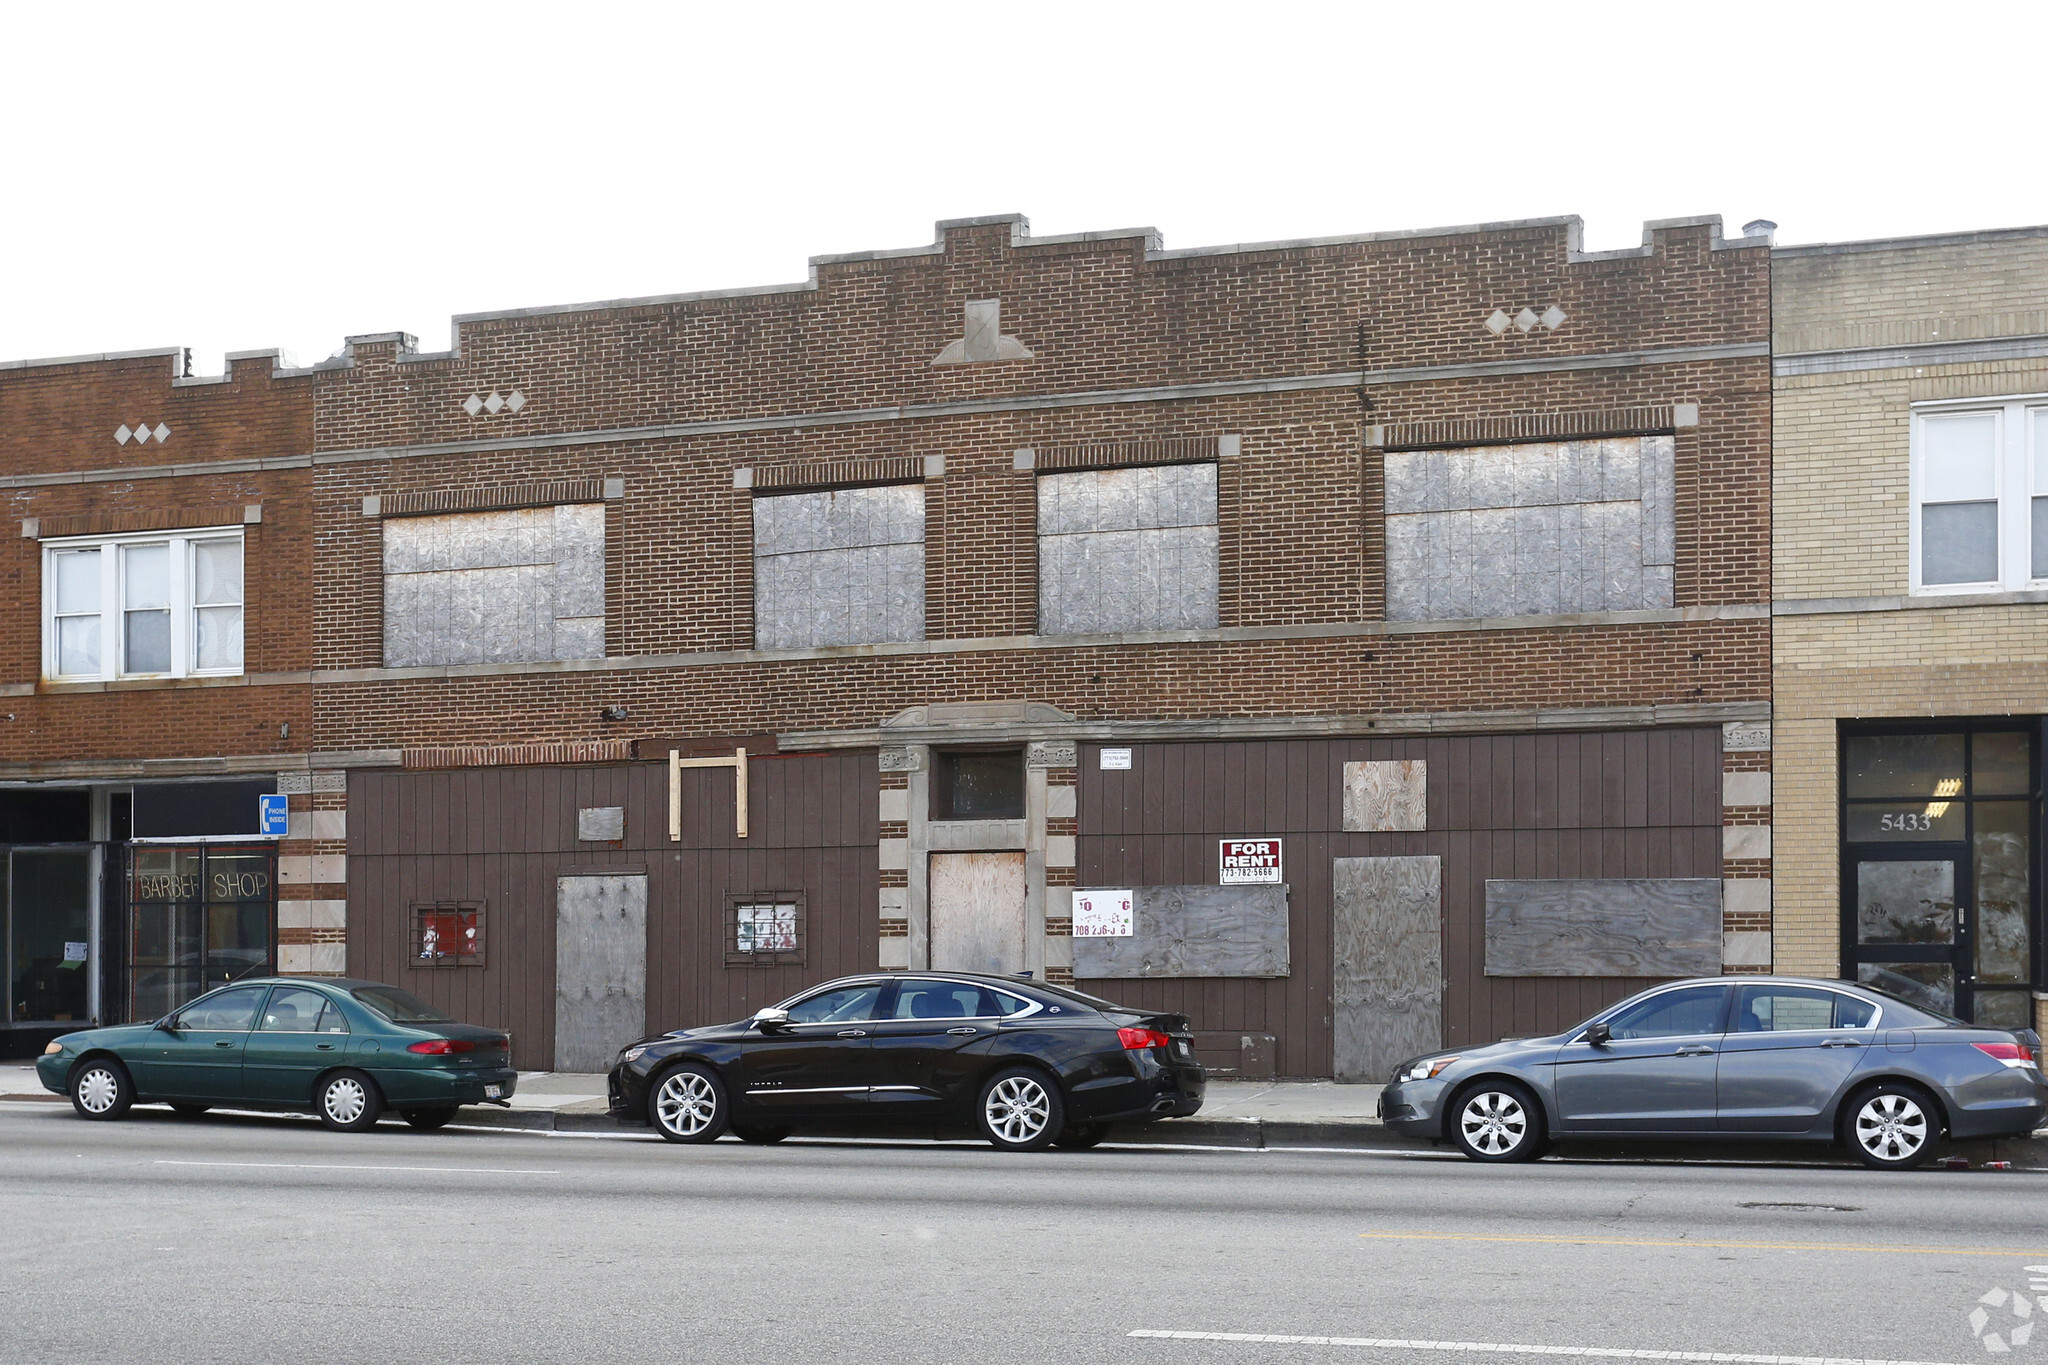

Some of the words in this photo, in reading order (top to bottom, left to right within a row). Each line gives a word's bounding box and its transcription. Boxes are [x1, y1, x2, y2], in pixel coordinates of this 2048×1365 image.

[268, 807, 286, 815] PHONE
[1880, 813, 1931, 831] 5433
[1231, 843, 1270, 856] FOR
[1224, 855, 1277, 868] RENT
[1220, 867, 1273, 878] 773-782-5666
[214, 873, 268, 898] SHOP
